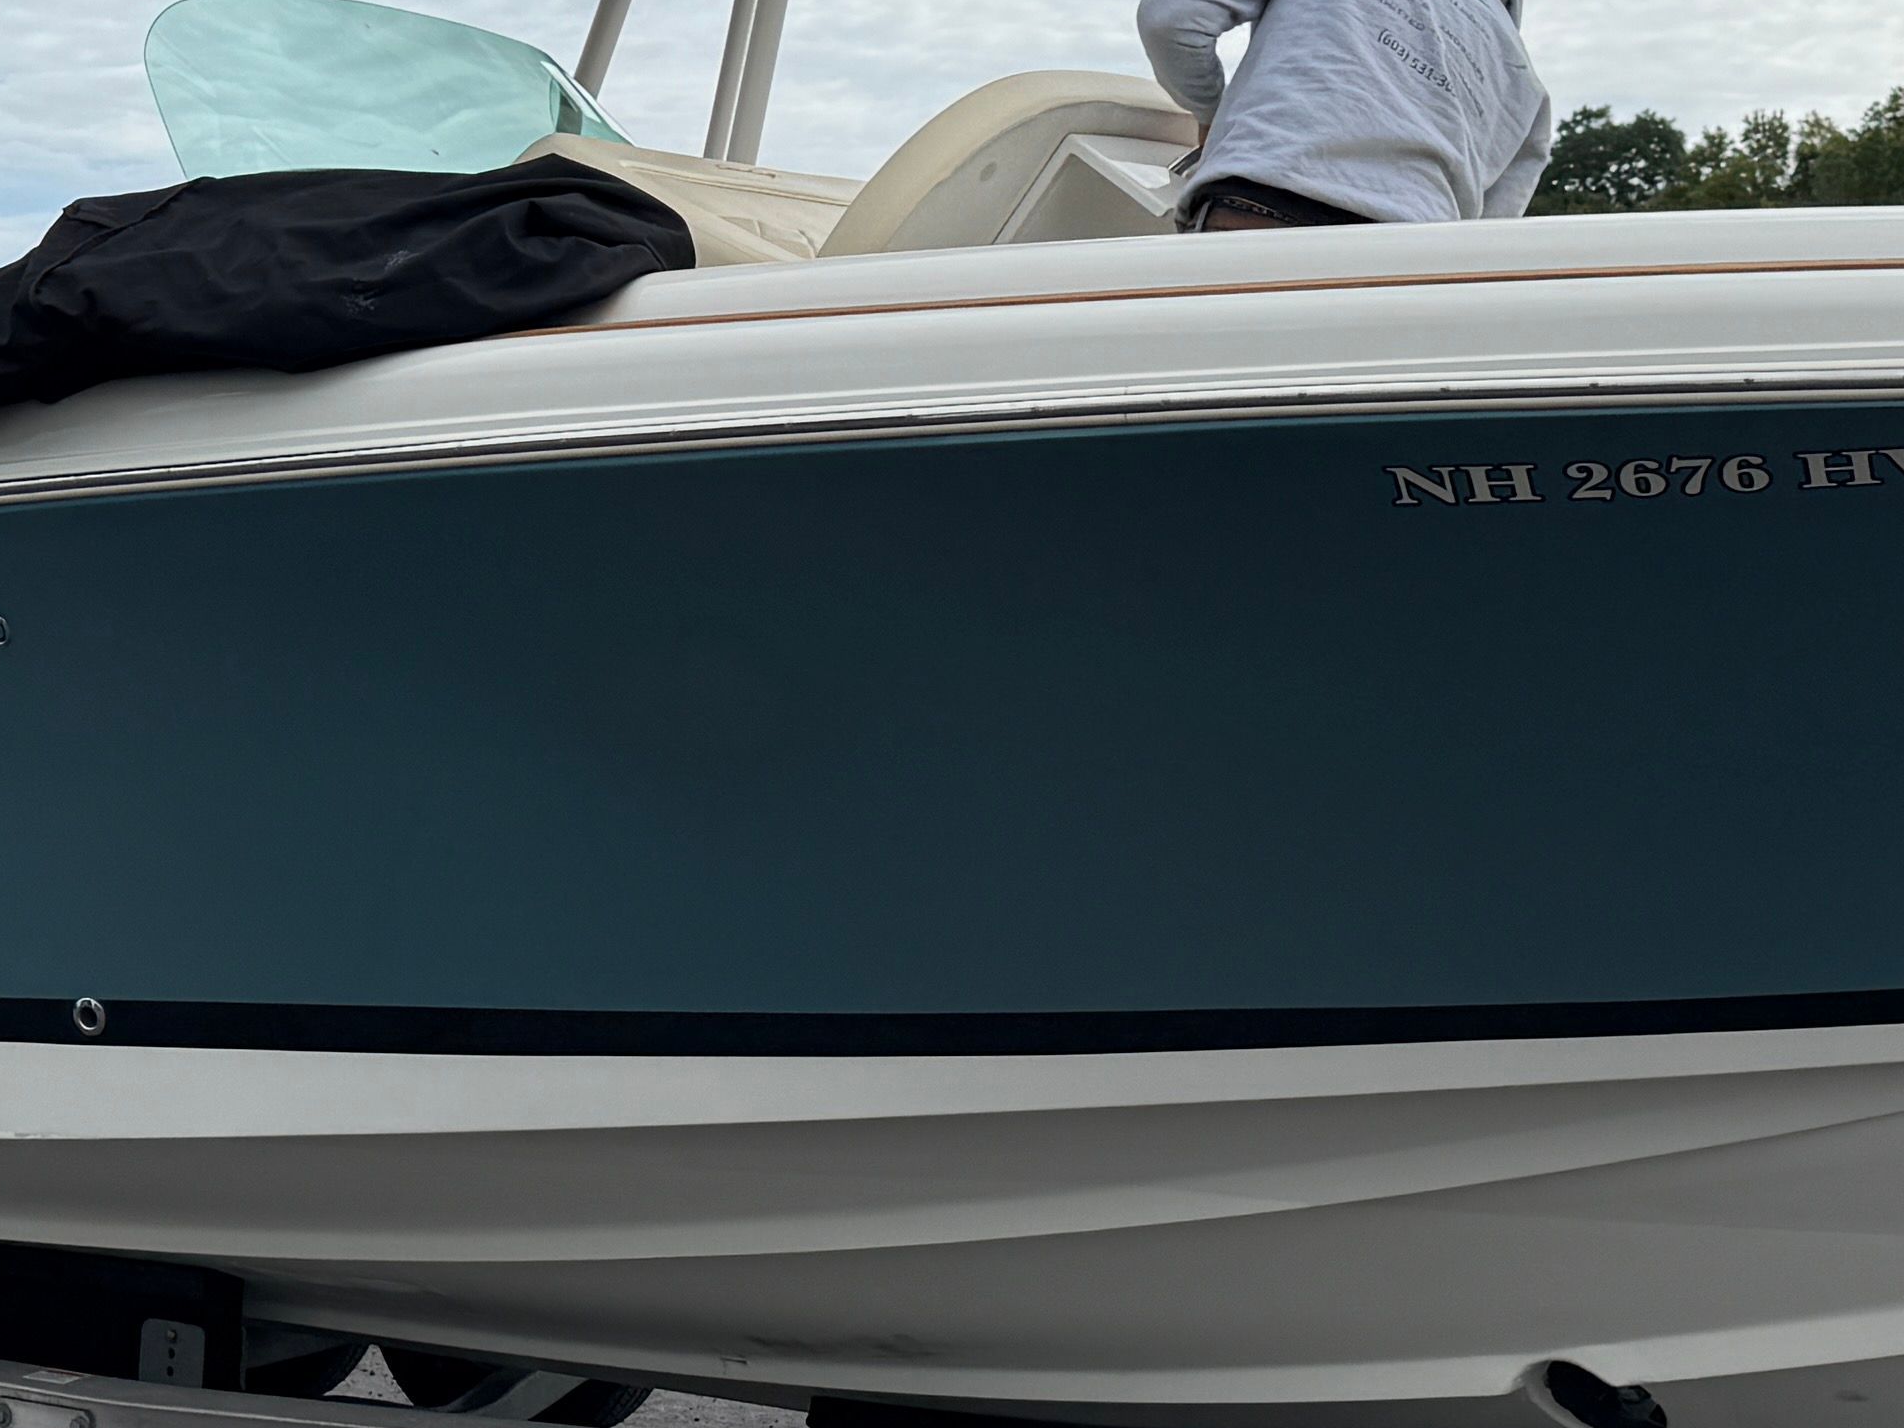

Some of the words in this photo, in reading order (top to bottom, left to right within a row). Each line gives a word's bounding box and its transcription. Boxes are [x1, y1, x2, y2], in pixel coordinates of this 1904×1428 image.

[1377, 28, 1410, 62] (603)
[1386, 462, 1544, 505] NH
[1563, 456, 1771, 501] 2676
